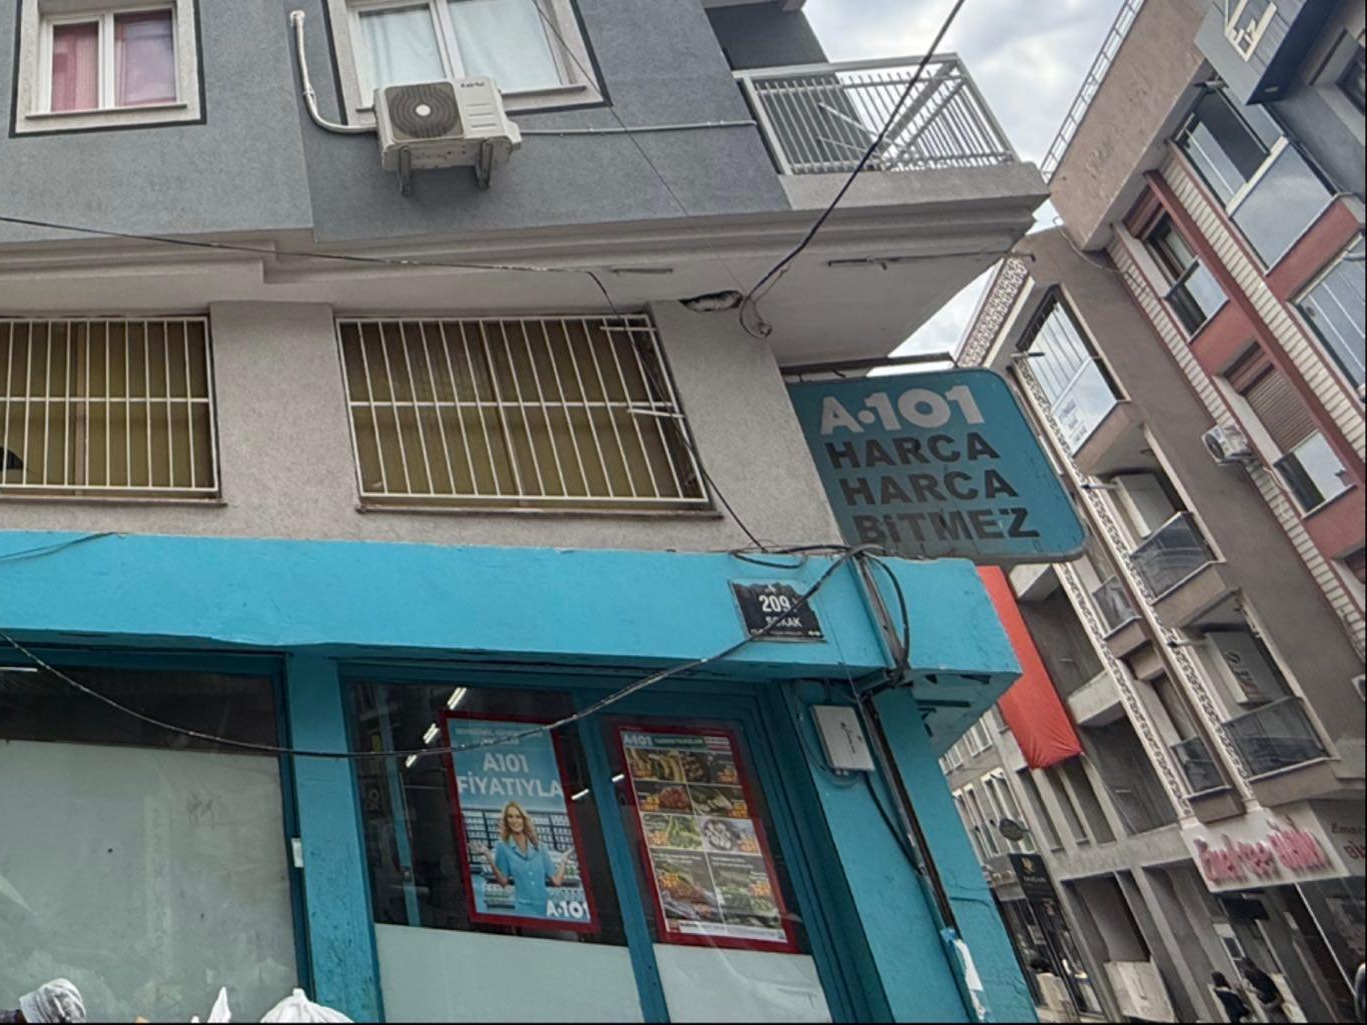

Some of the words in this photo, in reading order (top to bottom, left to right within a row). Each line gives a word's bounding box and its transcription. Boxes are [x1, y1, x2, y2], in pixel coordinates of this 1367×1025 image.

[825, 432, 1001, 470] HARCA
[839, 469, 1019, 507] HARCA
[482, 753, 529, 772] A101
[456, 771, 564, 797] FİYATIYLA
